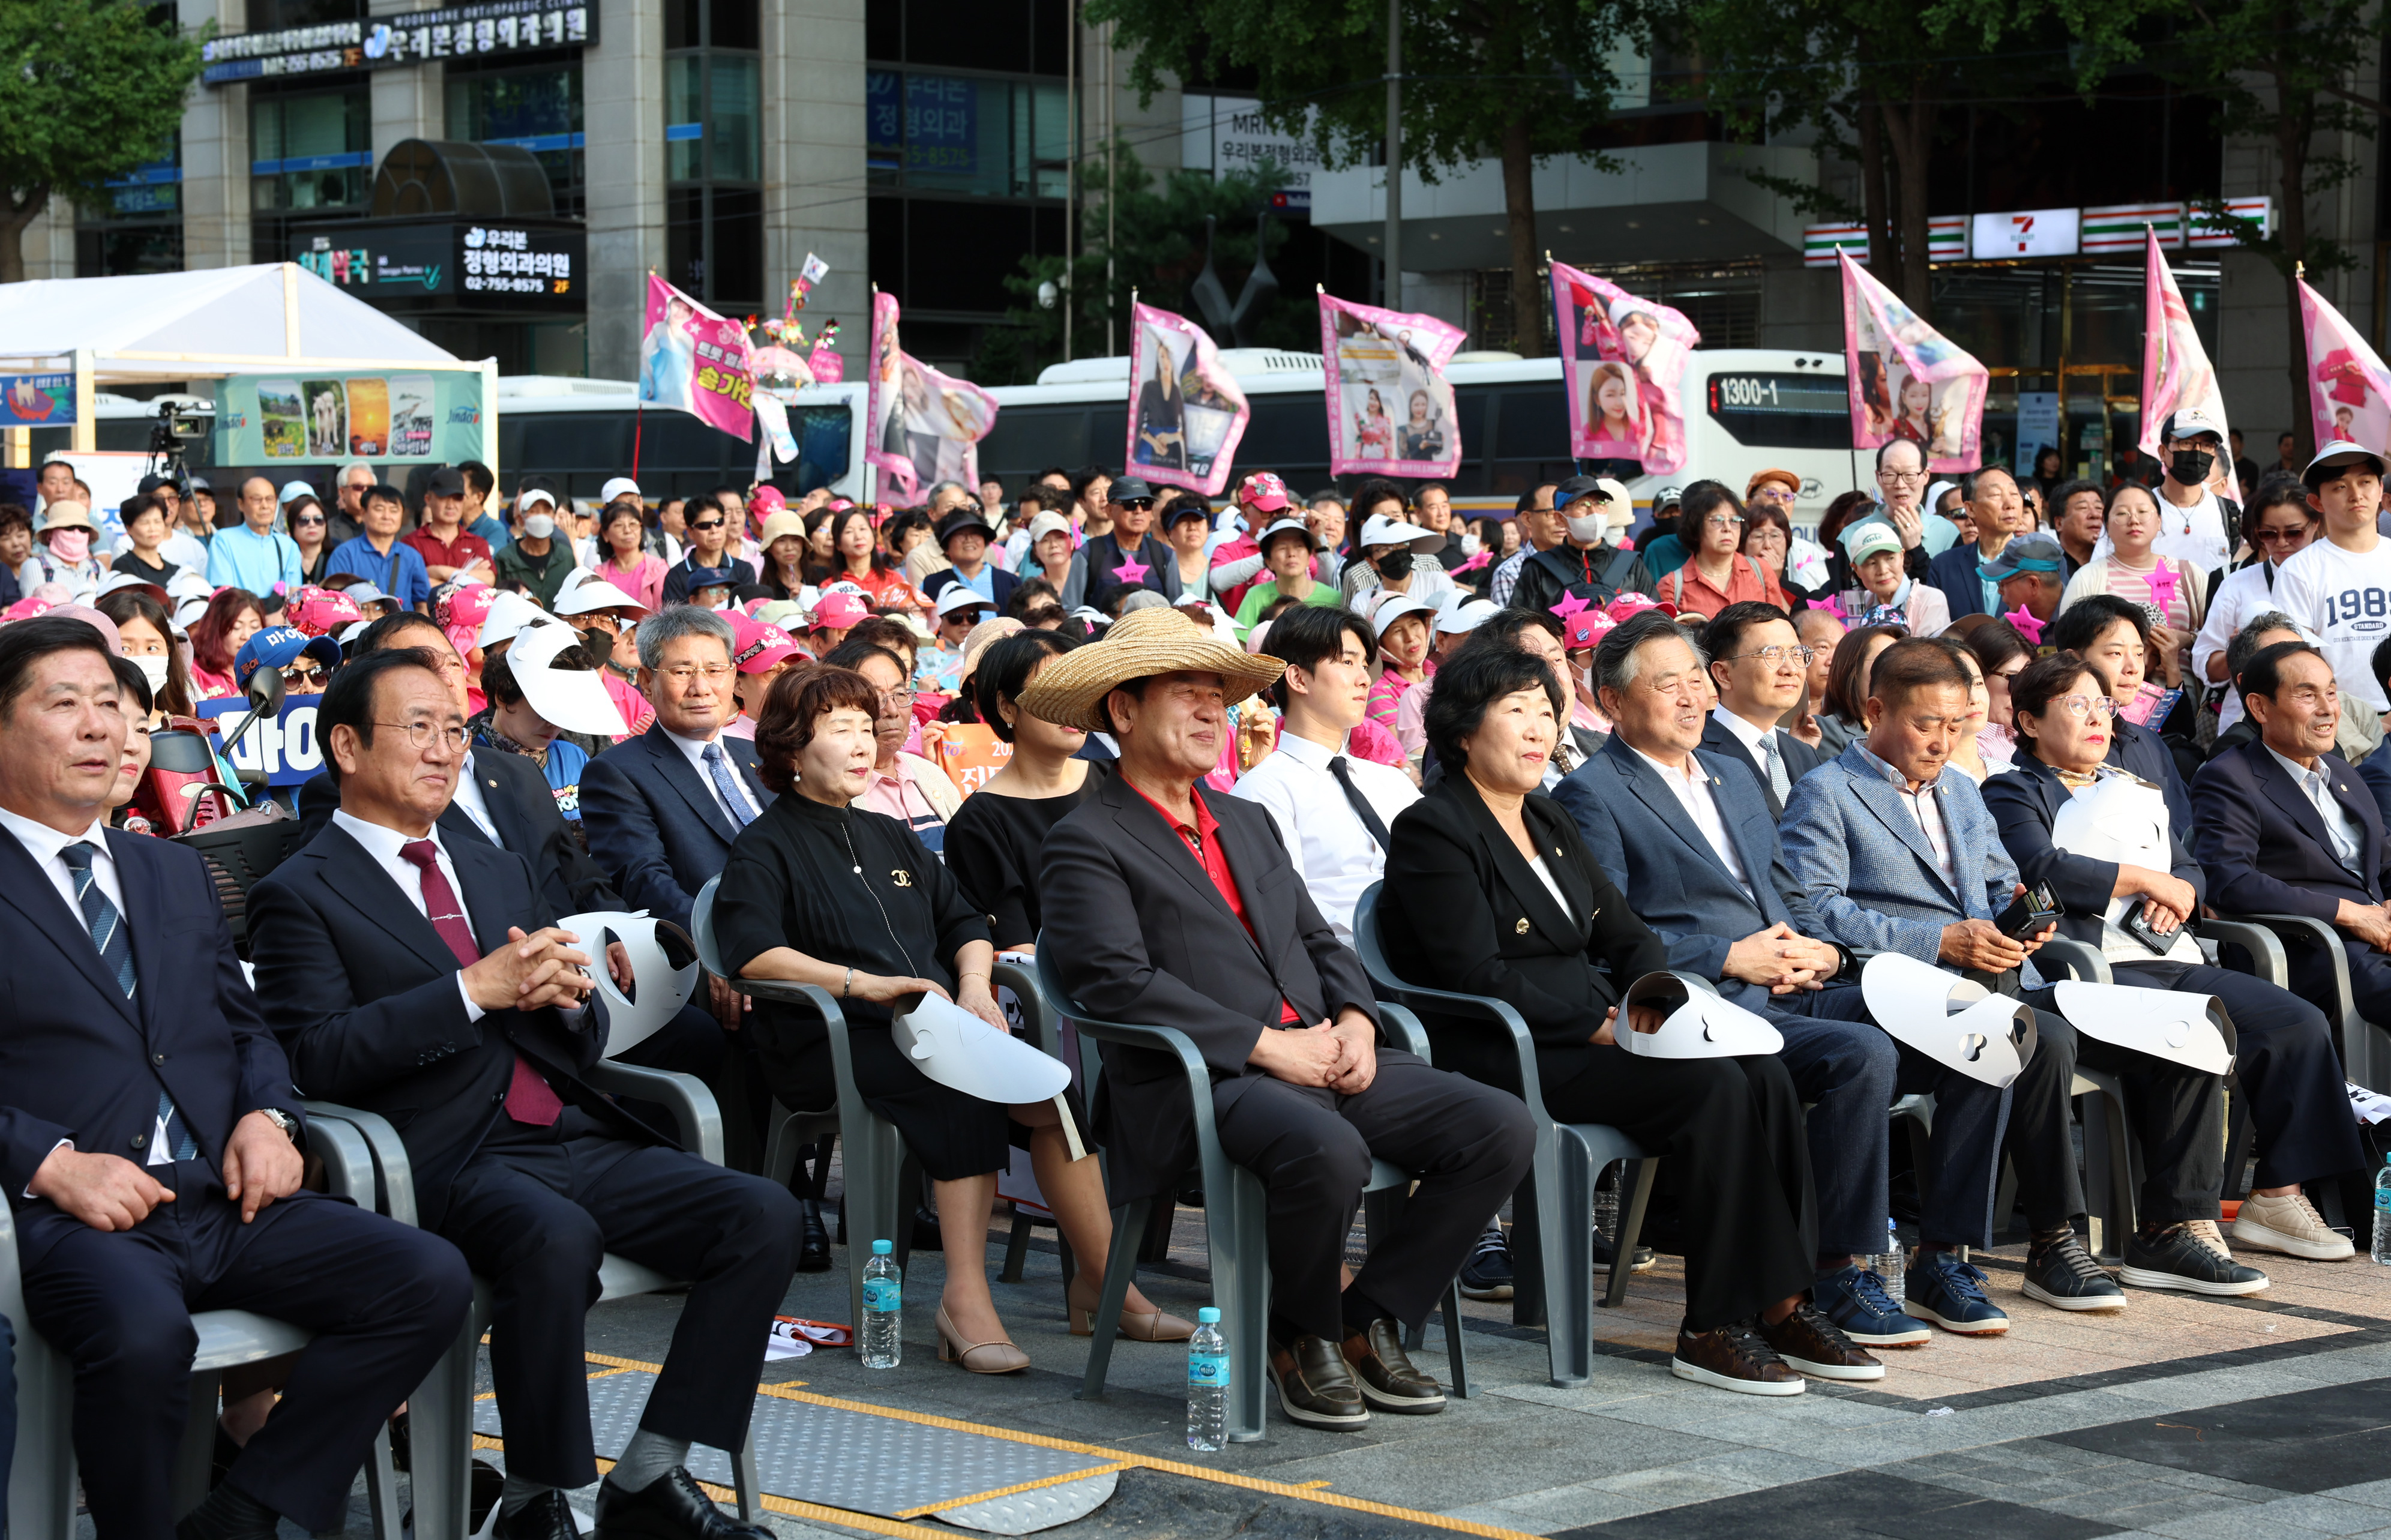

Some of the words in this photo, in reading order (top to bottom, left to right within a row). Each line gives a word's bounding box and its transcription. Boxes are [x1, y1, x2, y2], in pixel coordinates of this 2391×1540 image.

[389, 7, 587, 61] 우리본정형외과의원
[487, 230, 528, 250] 우리본
[463, 250, 570, 277] 정형외과의원
[465, 277, 544, 293] 02-755-8575
[553, 280, 570, 294] 2F
[1721, 377, 1778, 405] 1300-1
[332, 603, 358, 616] Again
[2326, 588, 2391, 628] 198
[760, 636, 792, 649] Again
